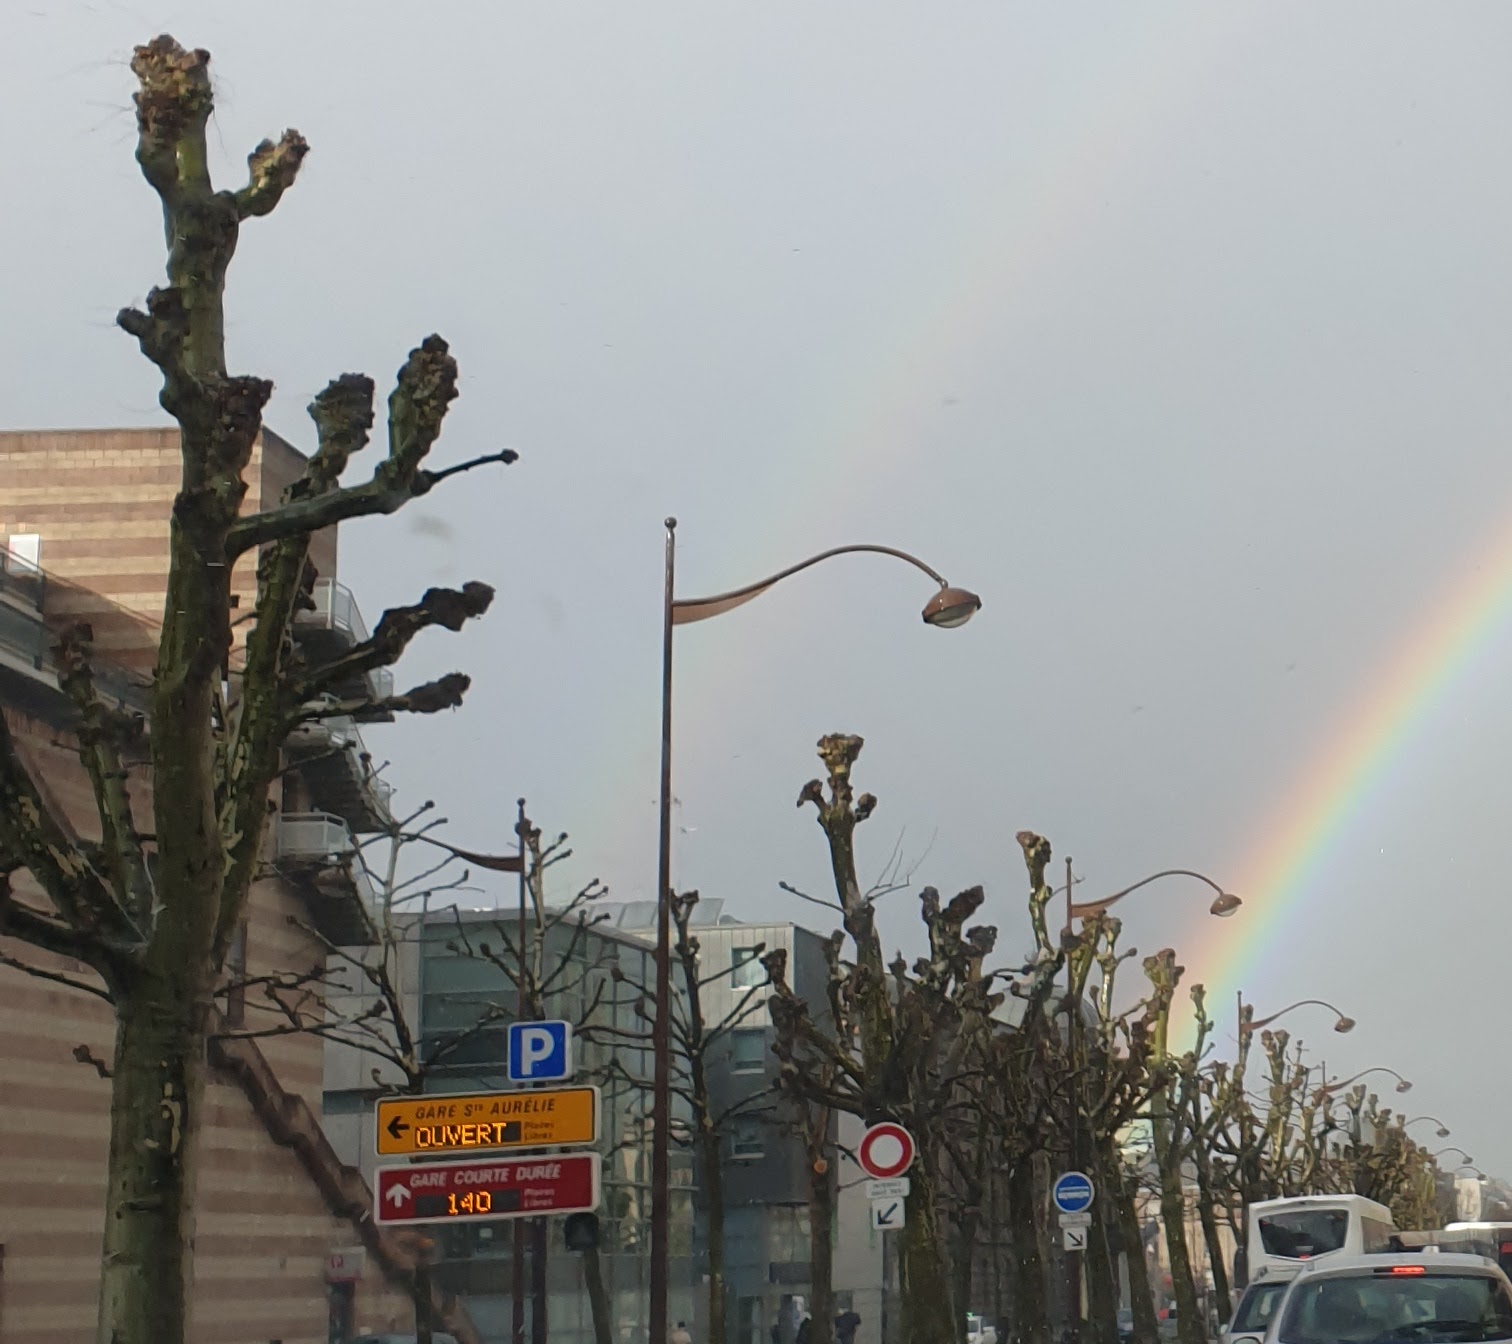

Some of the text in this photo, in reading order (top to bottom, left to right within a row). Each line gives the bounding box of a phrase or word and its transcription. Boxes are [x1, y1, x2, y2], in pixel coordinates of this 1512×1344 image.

[521, 1027, 555, 1077] P
[415, 1104, 457, 1120] GARE
[490, 1097, 556, 1116] AURÉLIE
[416, 1122, 507, 1148] OUVERT
[410, 1163, 562, 1188] GARE COURTE DURÉE
[447, 1190, 492, 1215] 140
